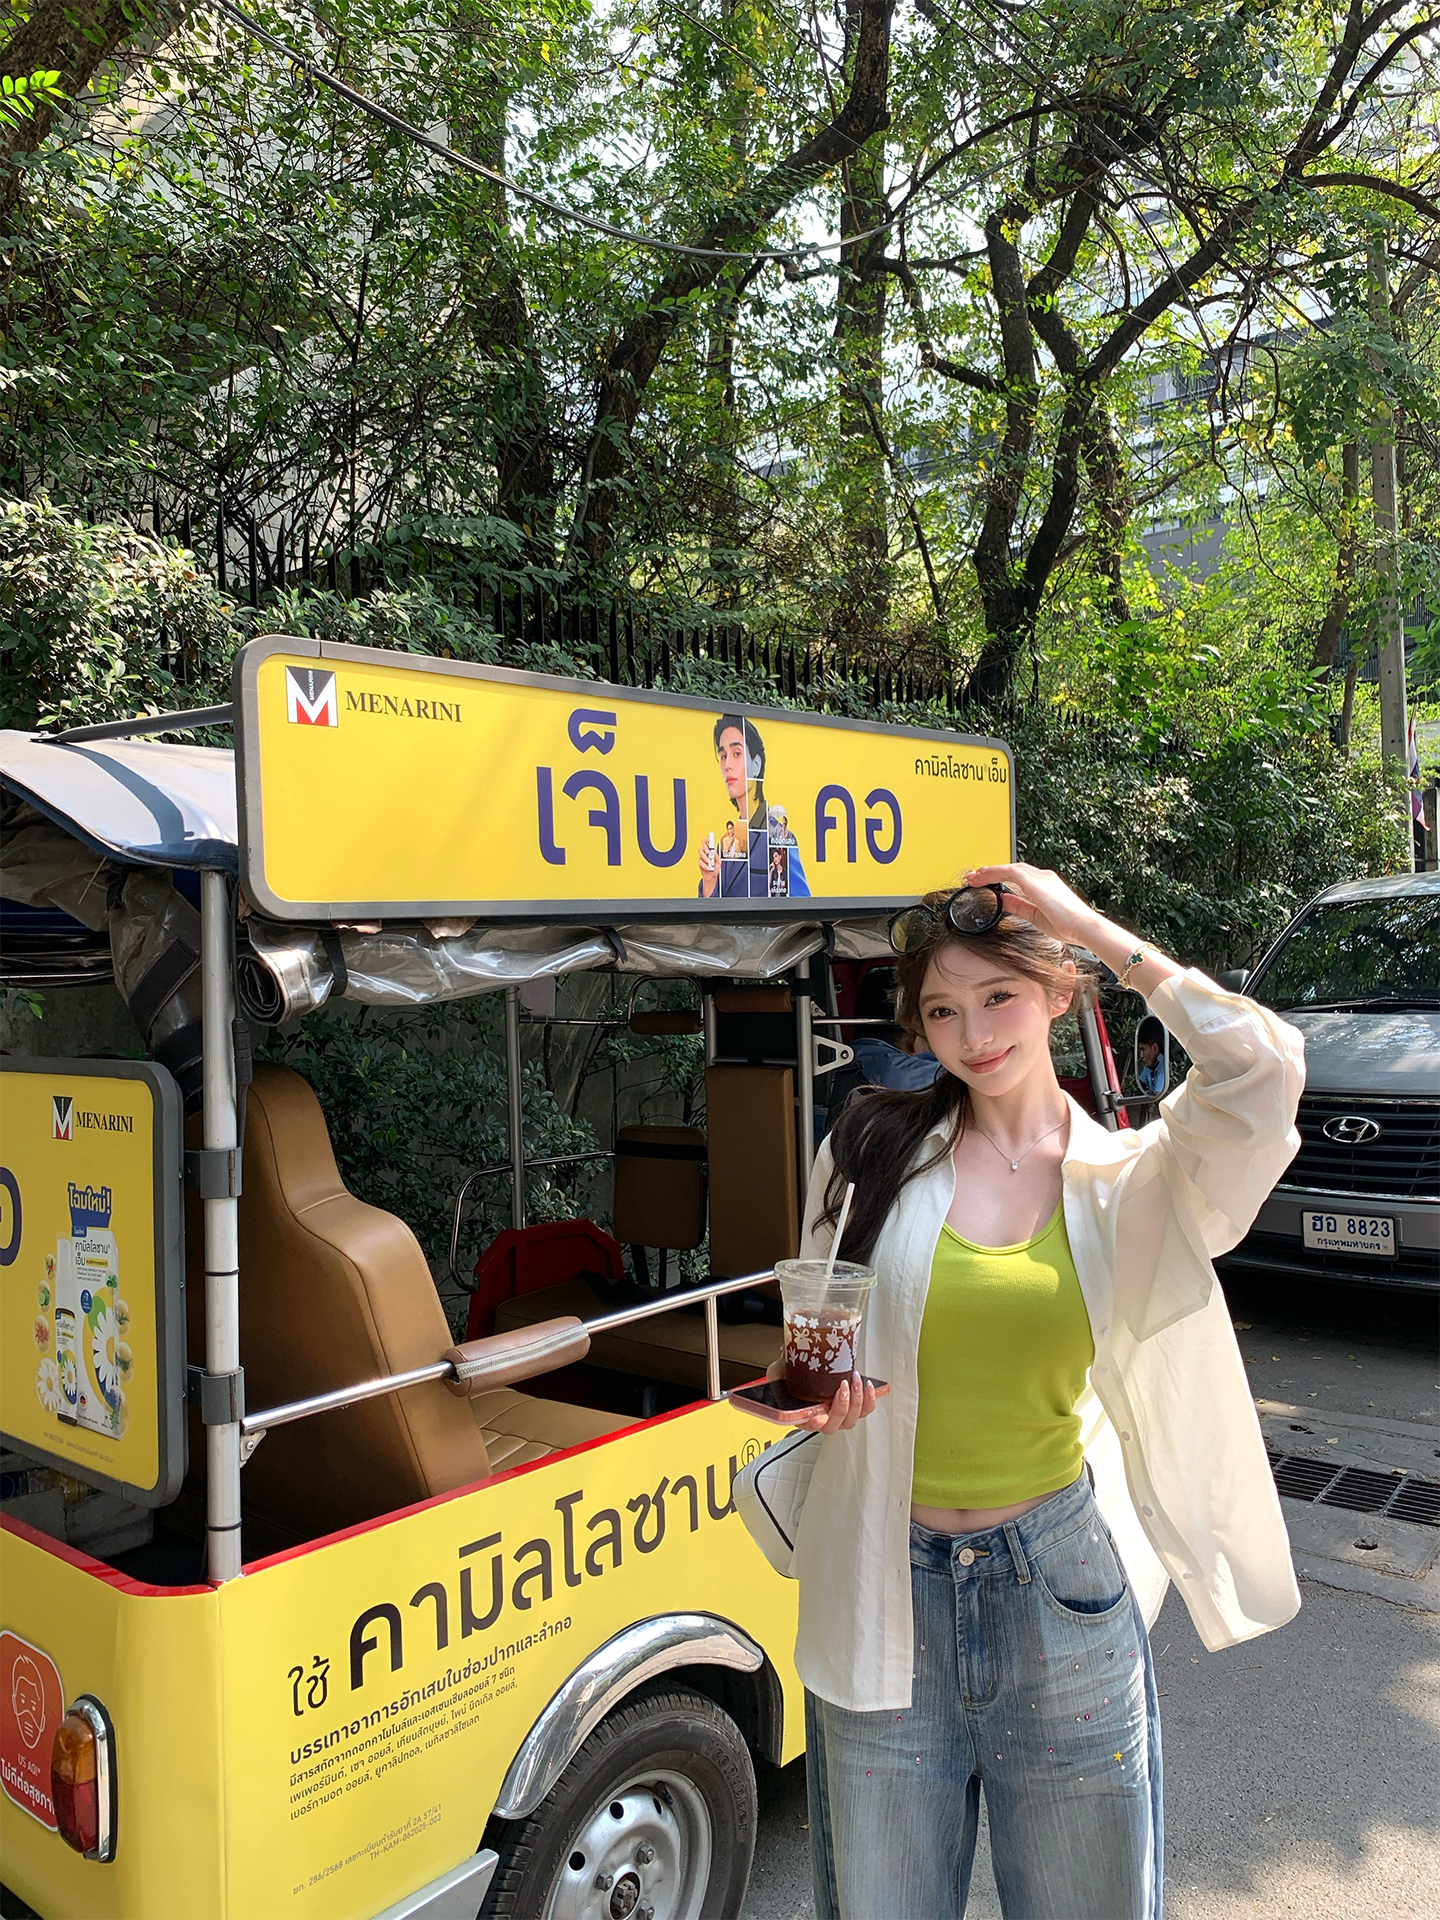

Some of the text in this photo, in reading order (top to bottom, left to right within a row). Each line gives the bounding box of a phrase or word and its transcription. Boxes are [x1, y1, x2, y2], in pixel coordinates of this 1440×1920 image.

[345, 690, 463, 723] MENARINI
[536, 708, 902, 868] เจ็บ คอ
[76, 1111, 134, 1133] MENARINI
[1347, 1218, 1390, 1238] 8823
[1317, 1237, 1381, 1250] กรุงเทพมหานคร
[287, 1655, 331, 1717] ใช้
[491, 1673, 498, 1685] 7
[0, 1757, 55, 1815] ไม่ดีต่อสุขภา
